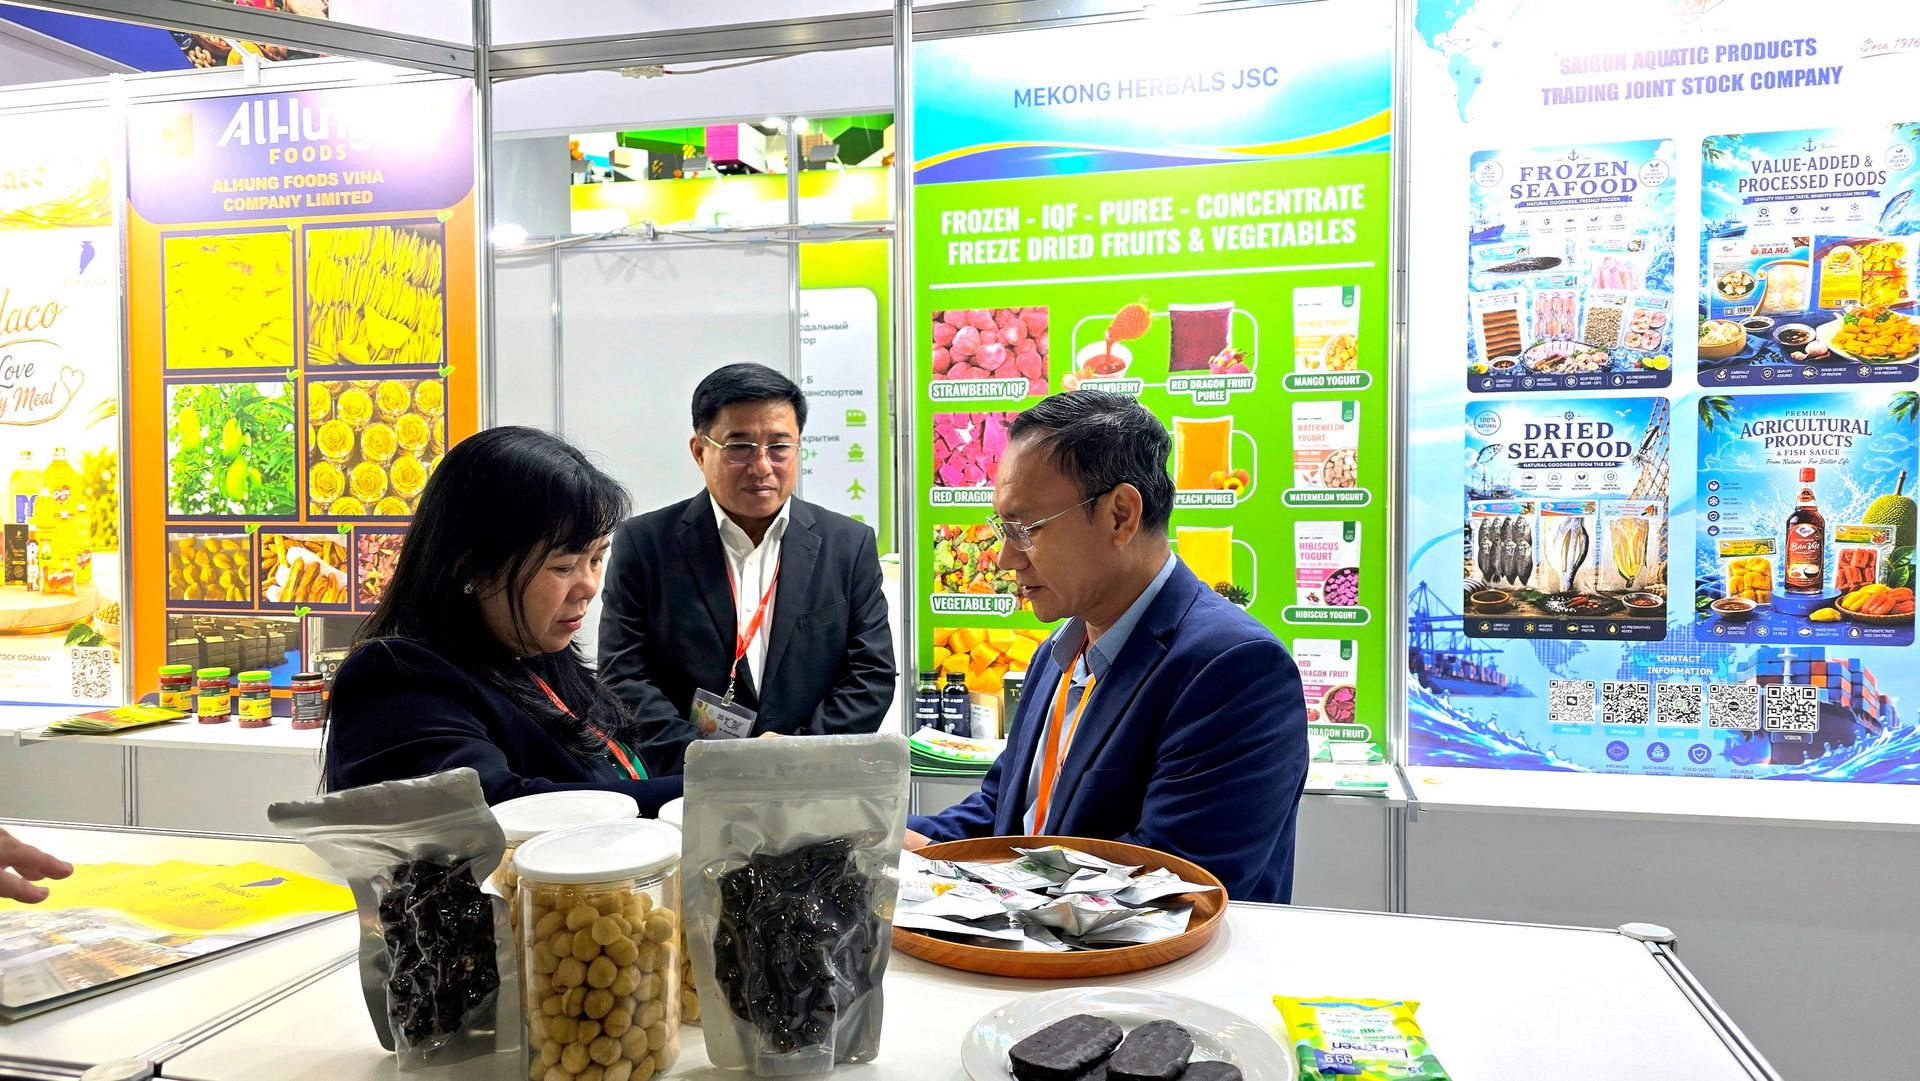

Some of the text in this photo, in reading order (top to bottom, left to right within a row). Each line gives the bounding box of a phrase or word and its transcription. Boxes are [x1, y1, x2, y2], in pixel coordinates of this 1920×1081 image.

[1560, 37, 1817, 75] SAIGON AQUATIC PRODUCTS
[1014, 66, 1279, 108] MEKONG HERBALS JSC
[1541, 65, 1844, 106] TRADING JOINT STOCK COMPANY
[269, 144, 347, 165] FOODS
[1751, 154, 1860, 175] VALUE-ADDED
[1864, 155, 1873, 167] &
[1520, 161, 1629, 182] FROZEN
[212, 170, 384, 193] ALHUNG FOODS VINA
[1738, 170, 1887, 193] PROCESSED FOODS
[1510, 178, 1638, 199] SEAFOOD
[223, 190, 374, 212] COMPANY LIMITED
[941, 206, 1019, 235] FROZEN
[1042, 203, 1078, 232] IQF
[1100, 196, 1174, 226] PUREE
[1196, 183, 1365, 220] CONCENTRATE
[948, 218, 1356, 266] FREEZE DRIED FRUITS & VEGETABLES
[800, 321, 849, 332] одальный
[1171, 378, 1253, 390] RED DRAGON FRUIT
[1294, 375, 1360, 387] MANGO YOGURT
[932, 382, 1025, 398] STRAWBERRY IQF
[1197, 390, 1226, 401] PUREE
[13, 382, 57, 412] Meal
[1297, 423, 1345, 432] WATERMELON
[1524, 422, 1614, 440] DRIED
[1740, 418, 1873, 440] AGRICULTURAL
[802, 435, 840, 443] крытия
[1298, 434, 1326, 442] YOGURT
[1764, 433, 1853, 449] PRODUCTS
[1508, 441, 1633, 460] SEAFOOD
[1784, 449, 1805, 457] FISH
[1838, 458, 1850, 466] Life
[933, 490, 994, 503] RED DRAGON
[1176, 494, 1233, 504] PEACH PUREE
[1290, 493, 1364, 502] WATERMELON YOGURT
[1299, 542, 1340, 551] HIBISCUS
[1299, 552, 1333, 561] YOGURT
[933, 597, 1013, 612] VEGETABLE IQF
[1295, 610, 1357, 619] HIBISCUS YOGURT
[18, 654, 51, 662] COMPANY
[1657, 655, 1701, 663] CONTACT
[1329, 670, 1350, 678] FRUIT
[1647, 666, 1714, 675] INFORMATION
[1342, 729, 1366, 738] FRUIT
